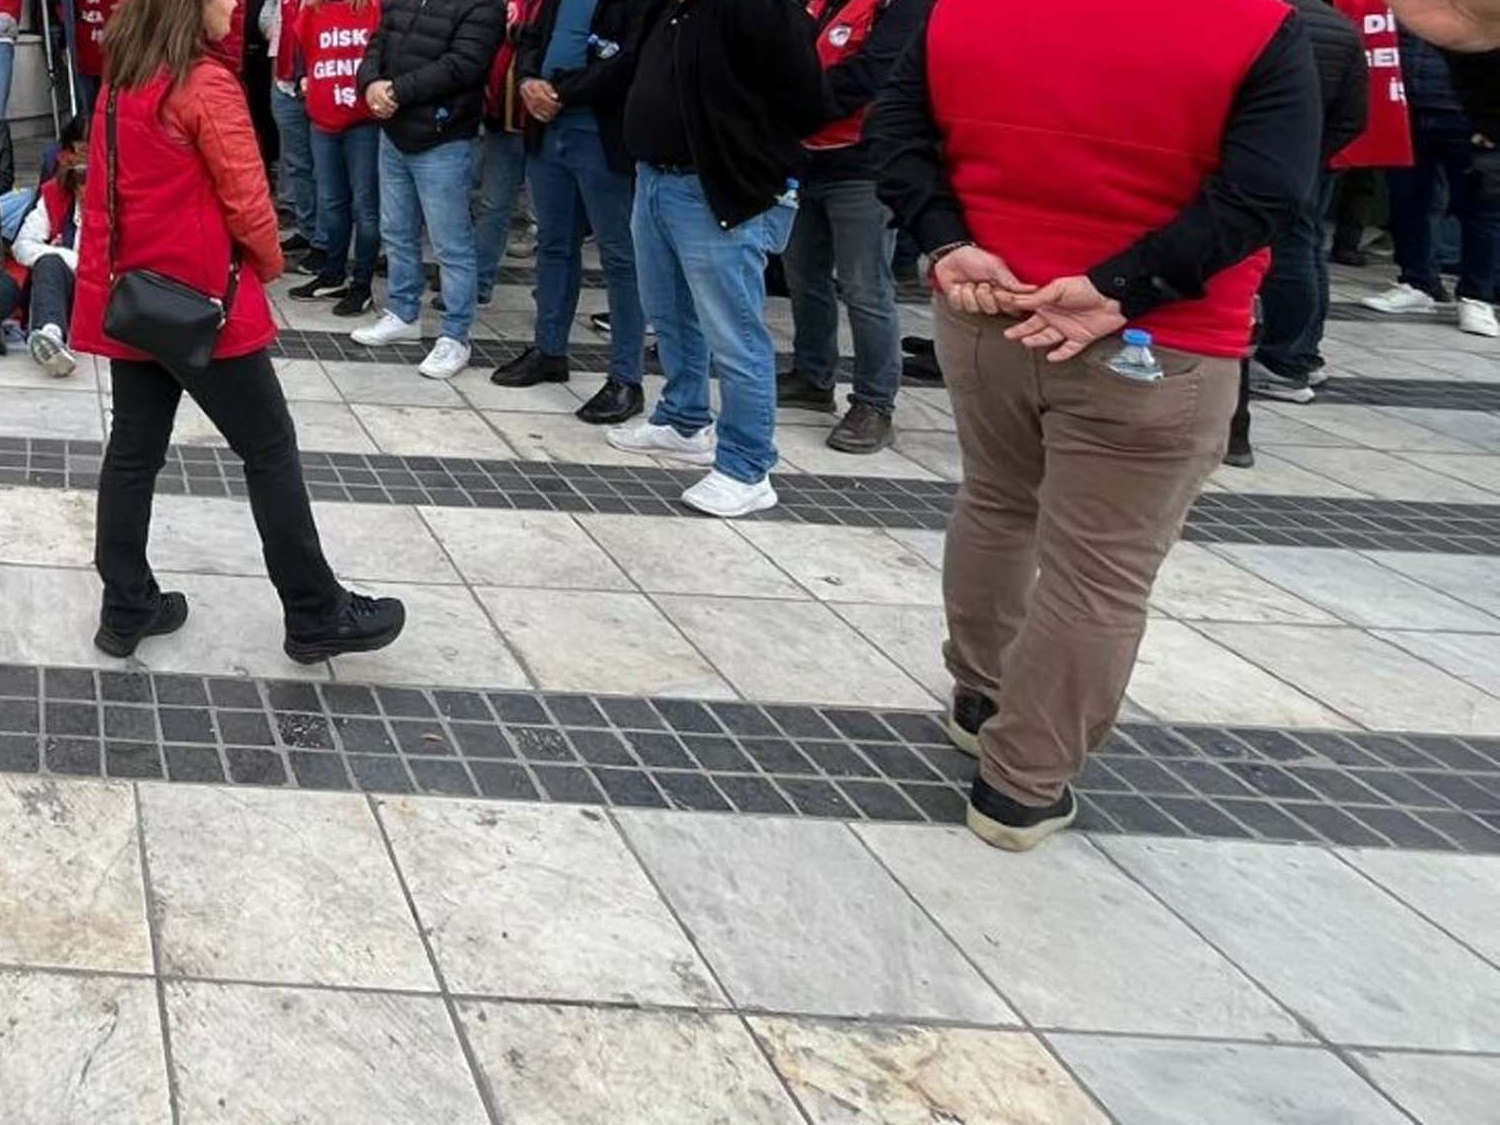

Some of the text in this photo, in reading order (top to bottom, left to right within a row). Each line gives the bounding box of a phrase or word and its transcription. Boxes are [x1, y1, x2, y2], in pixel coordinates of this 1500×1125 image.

[319, 27, 369, 49] DİSK
[314, 57, 363, 80] GEN
[333, 83, 357, 107] İŞ
